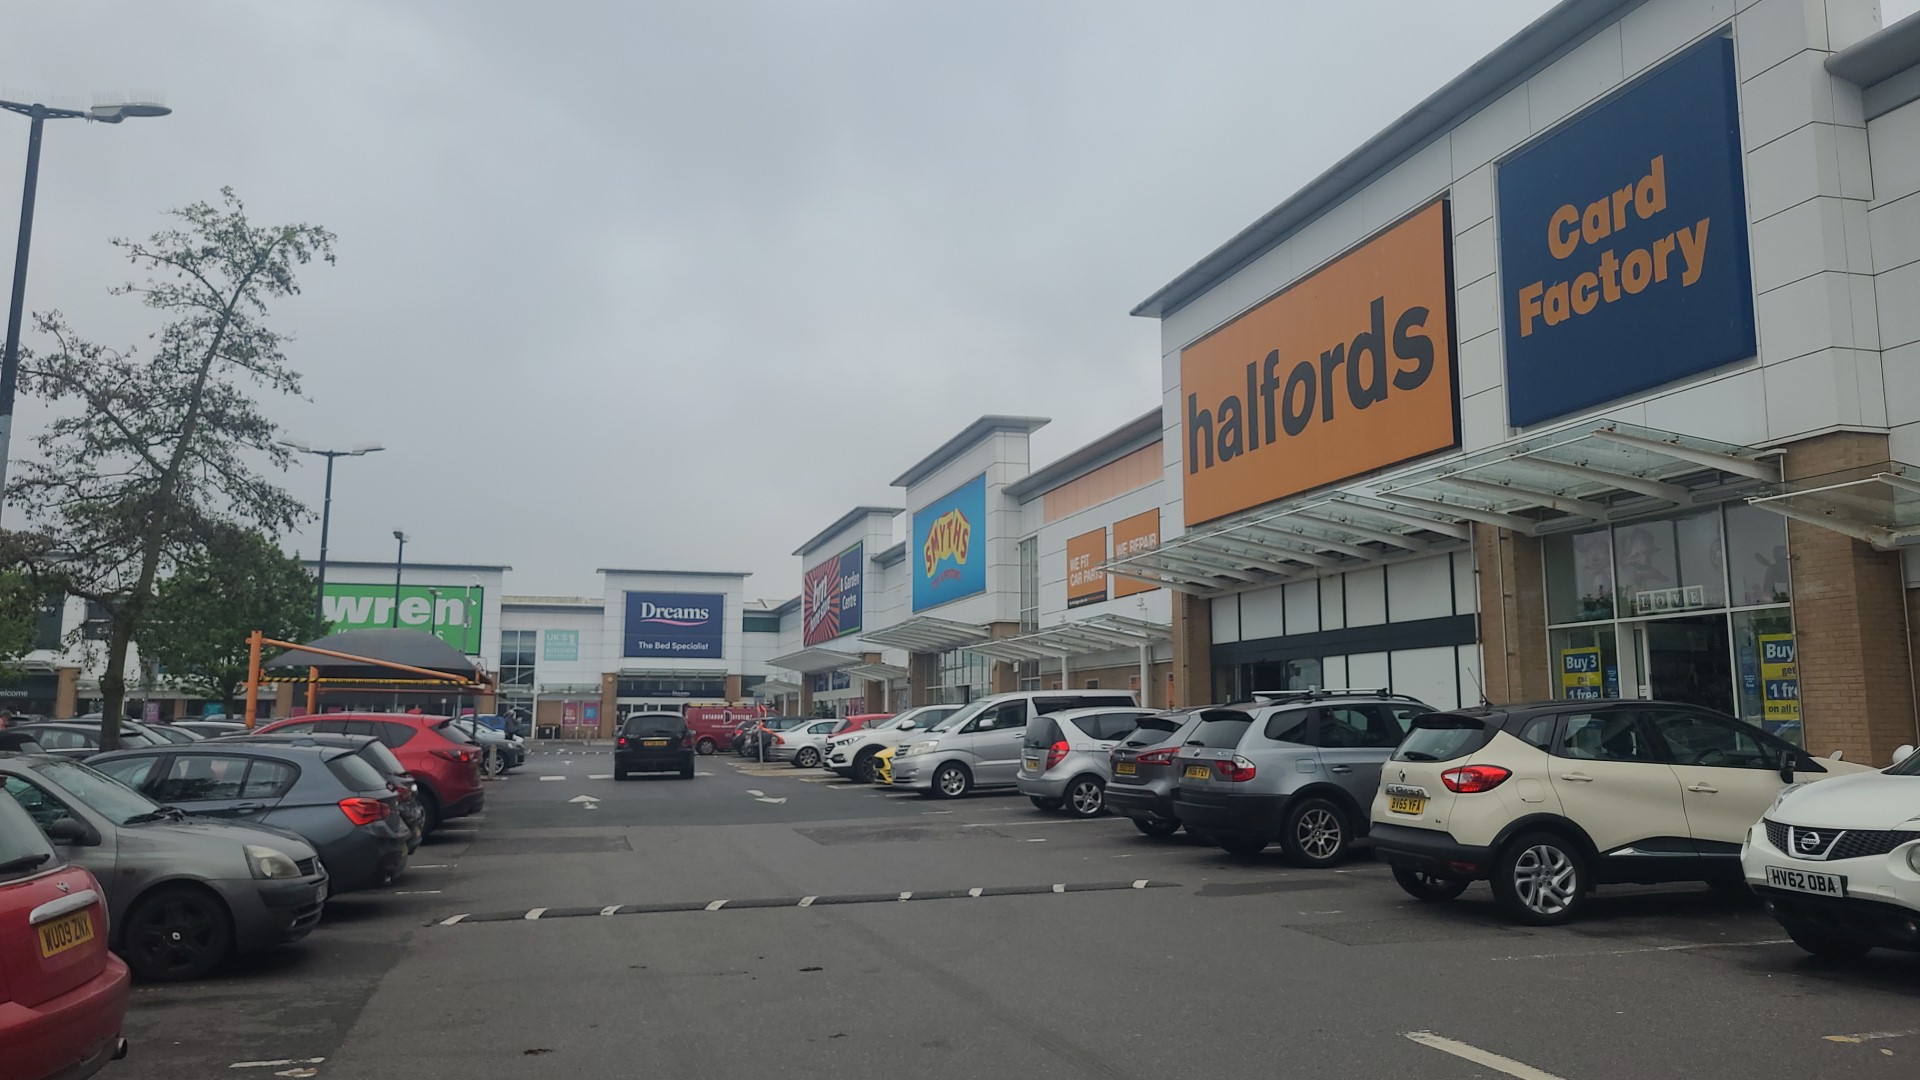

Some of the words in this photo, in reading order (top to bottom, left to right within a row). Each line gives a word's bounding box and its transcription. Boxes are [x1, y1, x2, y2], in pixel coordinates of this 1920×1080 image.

[1548, 154, 1667, 260] Card
[1519, 217, 1710, 338] Factory
[1188, 296, 1435, 475] halfords
[925, 517, 969, 573] SMYTHS
[1115, 541, 1128, 557] WE
[1129, 533, 1157, 553] REPAIR
[1069, 556, 1080, 571] WE
[1080, 553, 1090, 568] FIT
[844, 570, 860, 591] Garden
[1070, 570, 1083, 587] CAR
[1083, 567, 1104, 584] PARTS
[842, 593, 857, 611] Centre
[1641, 591, 1699, 608] LOVE
[321, 595, 465, 626] wren
[640, 601, 710, 620] Dreams
[638, 641, 653, 649] The
[654, 641, 671, 650] Bed
[671, 642, 709, 652] Specialist
[1766, 643, 1795, 662] Buy
[1565, 656, 1588, 672] Buy
[1589, 654, 1598, 668] 3
[0, 689, 28, 697] elcome
[1568, 690, 1575, 700] 1
[1577, 688, 1598, 700] free
[1770, 683, 1779, 698] 1
[1780, 704, 1792, 713] all
[1771, 868, 1805, 889] HV62
[1808, 874, 1837, 893] OBA
[43, 922, 73, 951] WU09
[71, 915, 91, 941] ZNX
